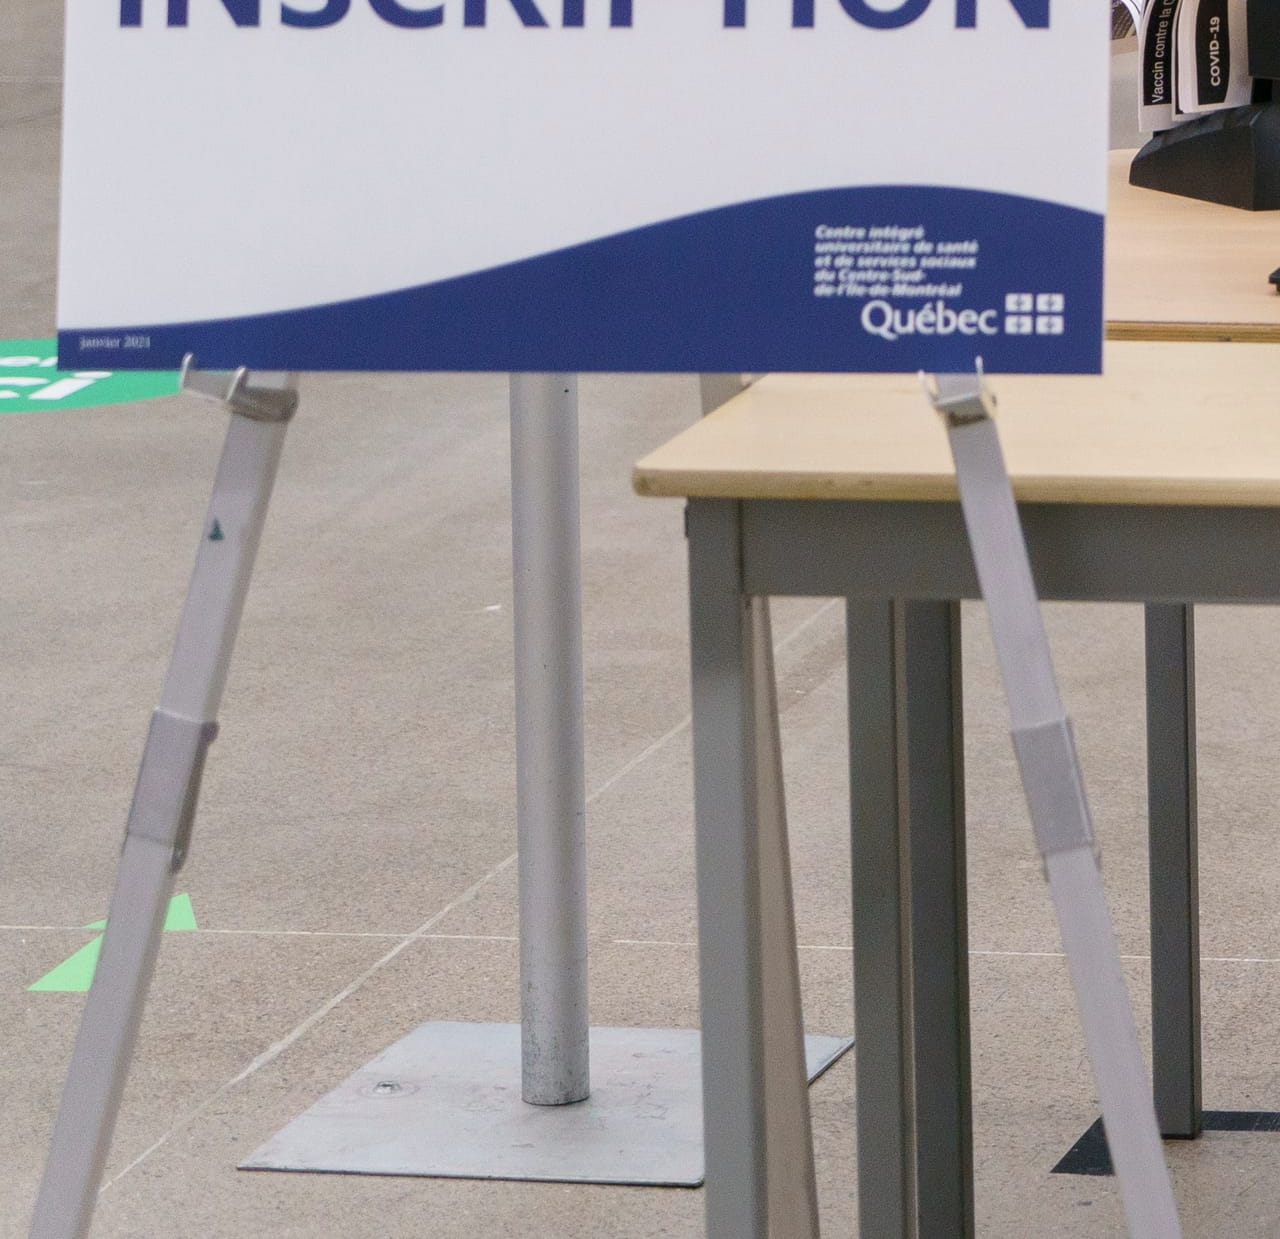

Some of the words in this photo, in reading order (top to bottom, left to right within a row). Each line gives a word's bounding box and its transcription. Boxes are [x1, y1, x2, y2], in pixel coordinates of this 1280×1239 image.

[1159, 8, 1172, 18] la
[1154, 19, 1169, 58] contre
[1210, 16, 1220, 87] COVID-19
[1152, 62, 1164, 103] Vaccin
[815, 225, 866, 240] Centre
[868, 225, 924, 242] intégré
[815, 240, 910, 254] universitaire
[913, 240, 934, 254] de
[937, 240, 979, 254] santé
[815, 255, 831, 268] et
[834, 254, 854, 268] de
[857, 255, 917, 268] services
[920, 255, 977, 269] sociaux
[815, 269, 835, 282] du
[861, 299, 998, 341] Québec
[80, 336, 121, 350] janvier
[124, 335, 151, 348] 2021
